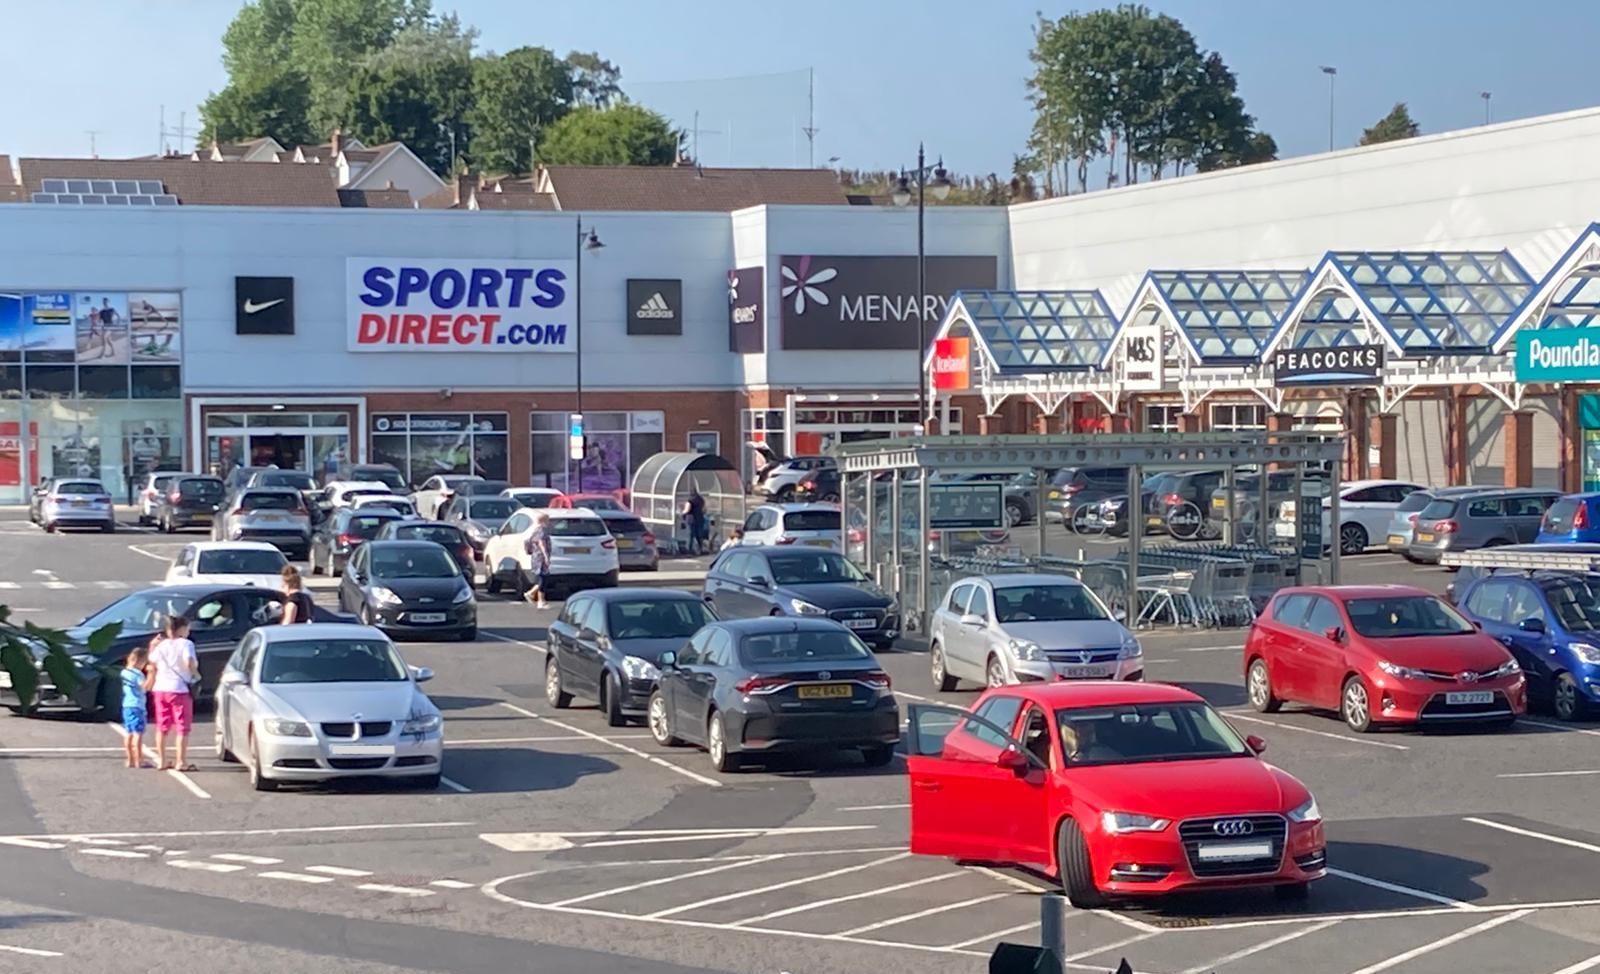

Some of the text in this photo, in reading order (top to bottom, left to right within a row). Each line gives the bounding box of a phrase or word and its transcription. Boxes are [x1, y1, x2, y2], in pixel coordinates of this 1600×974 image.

[359, 266, 567, 309] SPORTS
[636, 310, 674, 319] adidas
[1126, 336, 1155, 362] M&S
[1276, 349, 1377, 370] PEACOCKS
[936, 355, 967, 373] Iceland
